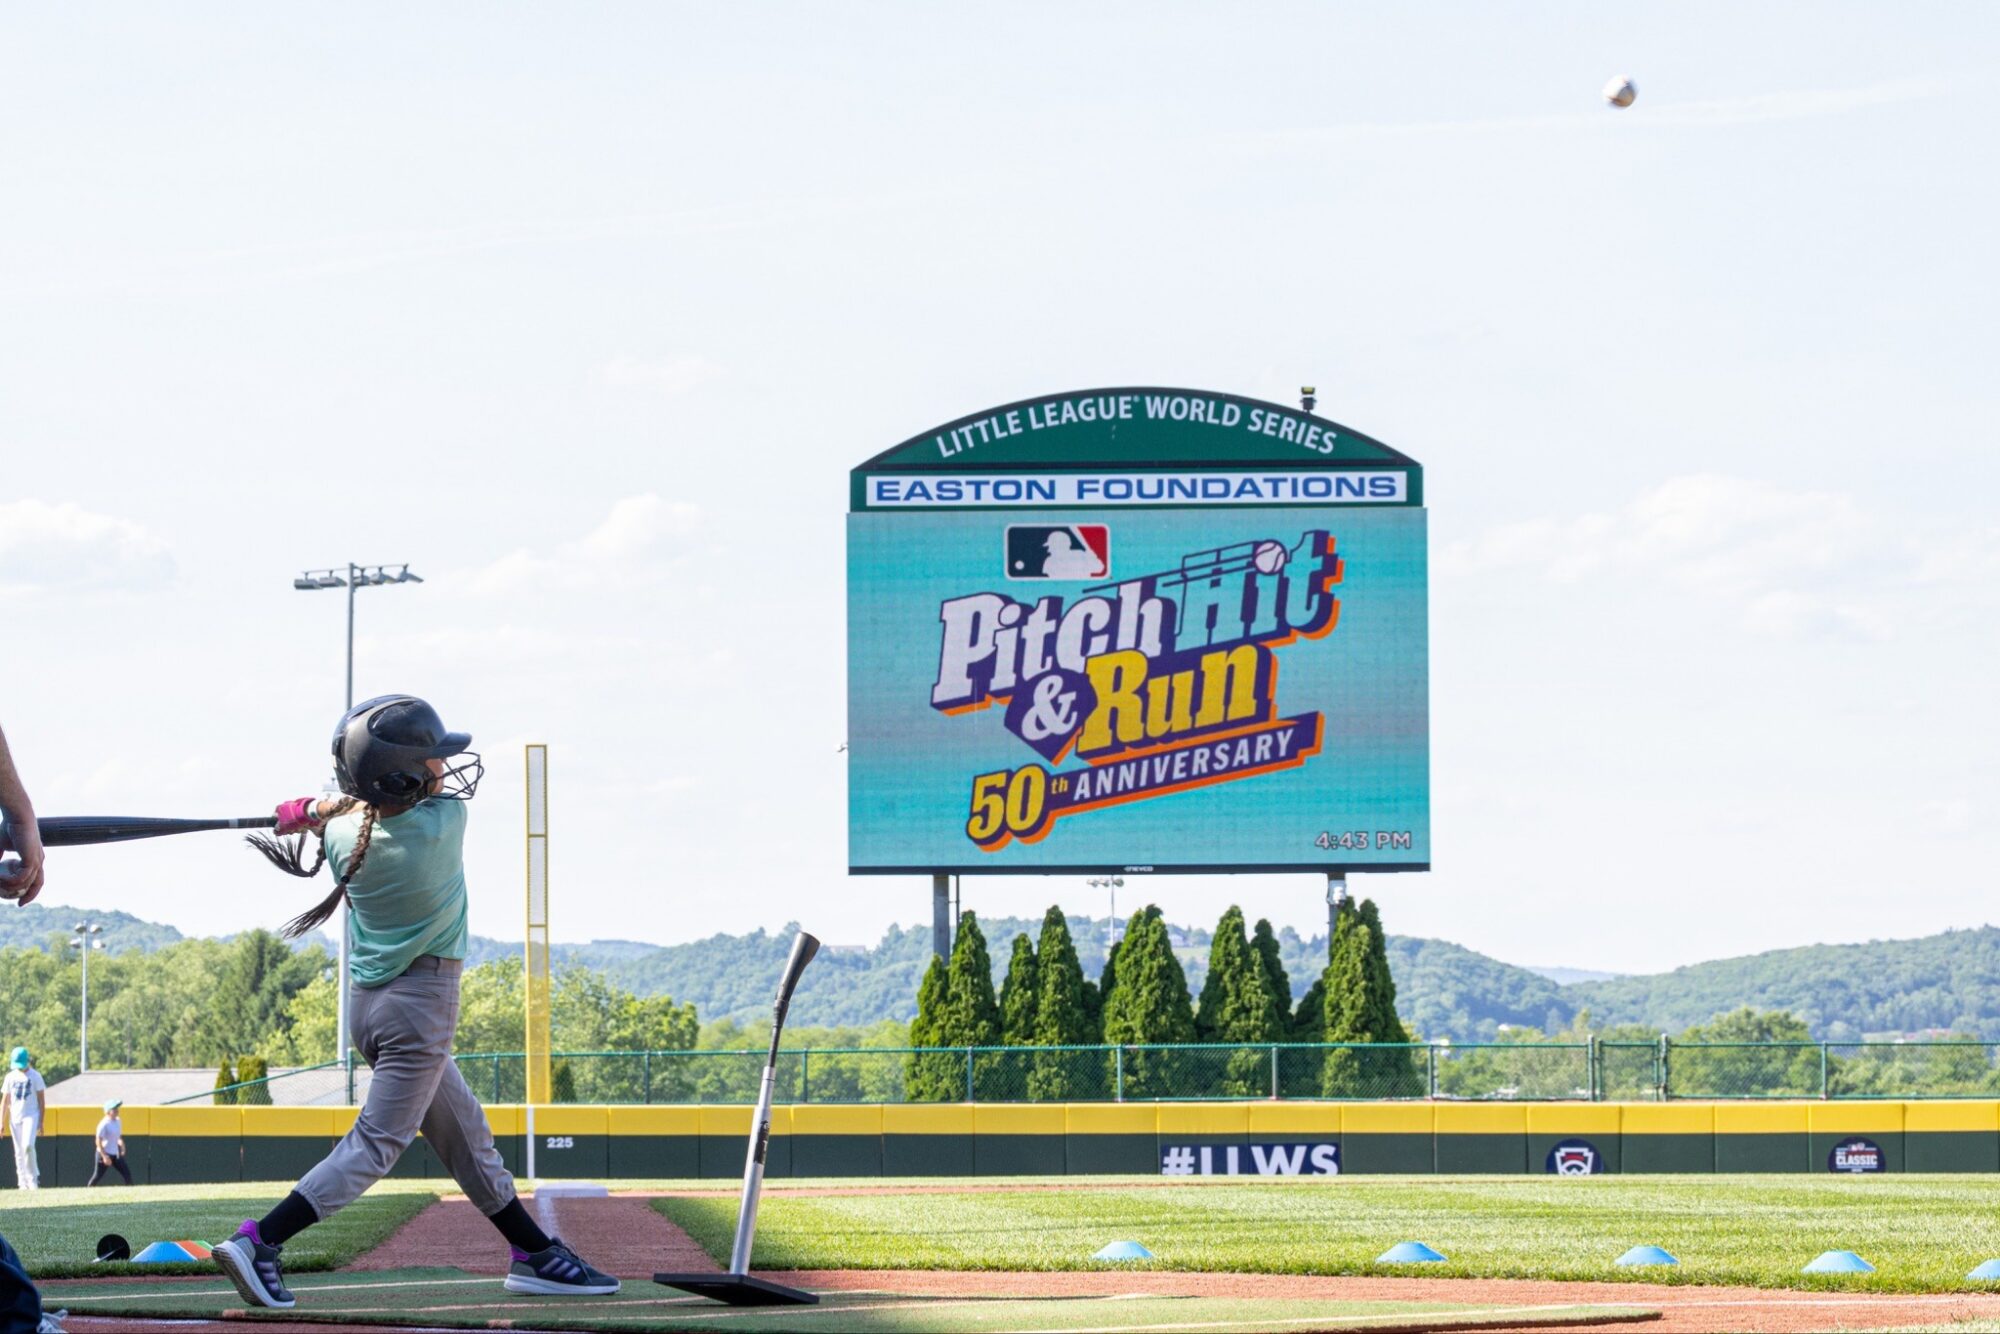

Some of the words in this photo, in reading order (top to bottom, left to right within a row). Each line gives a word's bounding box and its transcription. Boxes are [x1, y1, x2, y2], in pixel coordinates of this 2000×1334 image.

[936, 410, 1023, 458] LITTLE
[1145, 396, 1241, 427] WORLD
[1247, 409, 1338, 454] SERIES
[876, 479, 1056, 500] EASTON
[1077, 476, 1397, 499] FOUNDATIONS
[932, 580, 1164, 704] Pitch
[1174, 530, 1330, 653] Hit
[1021, 675, 1078, 740] &
[1077, 644, 1260, 752] Run
[1074, 729, 1294, 801] ANNIVERSARY
[1315, 831, 1369, 850] 4:43
[1376, 831, 1411, 850] PM
[546, 1136, 574, 1149] 225
[1835, 1154, 1878, 1166] CLASSIC
